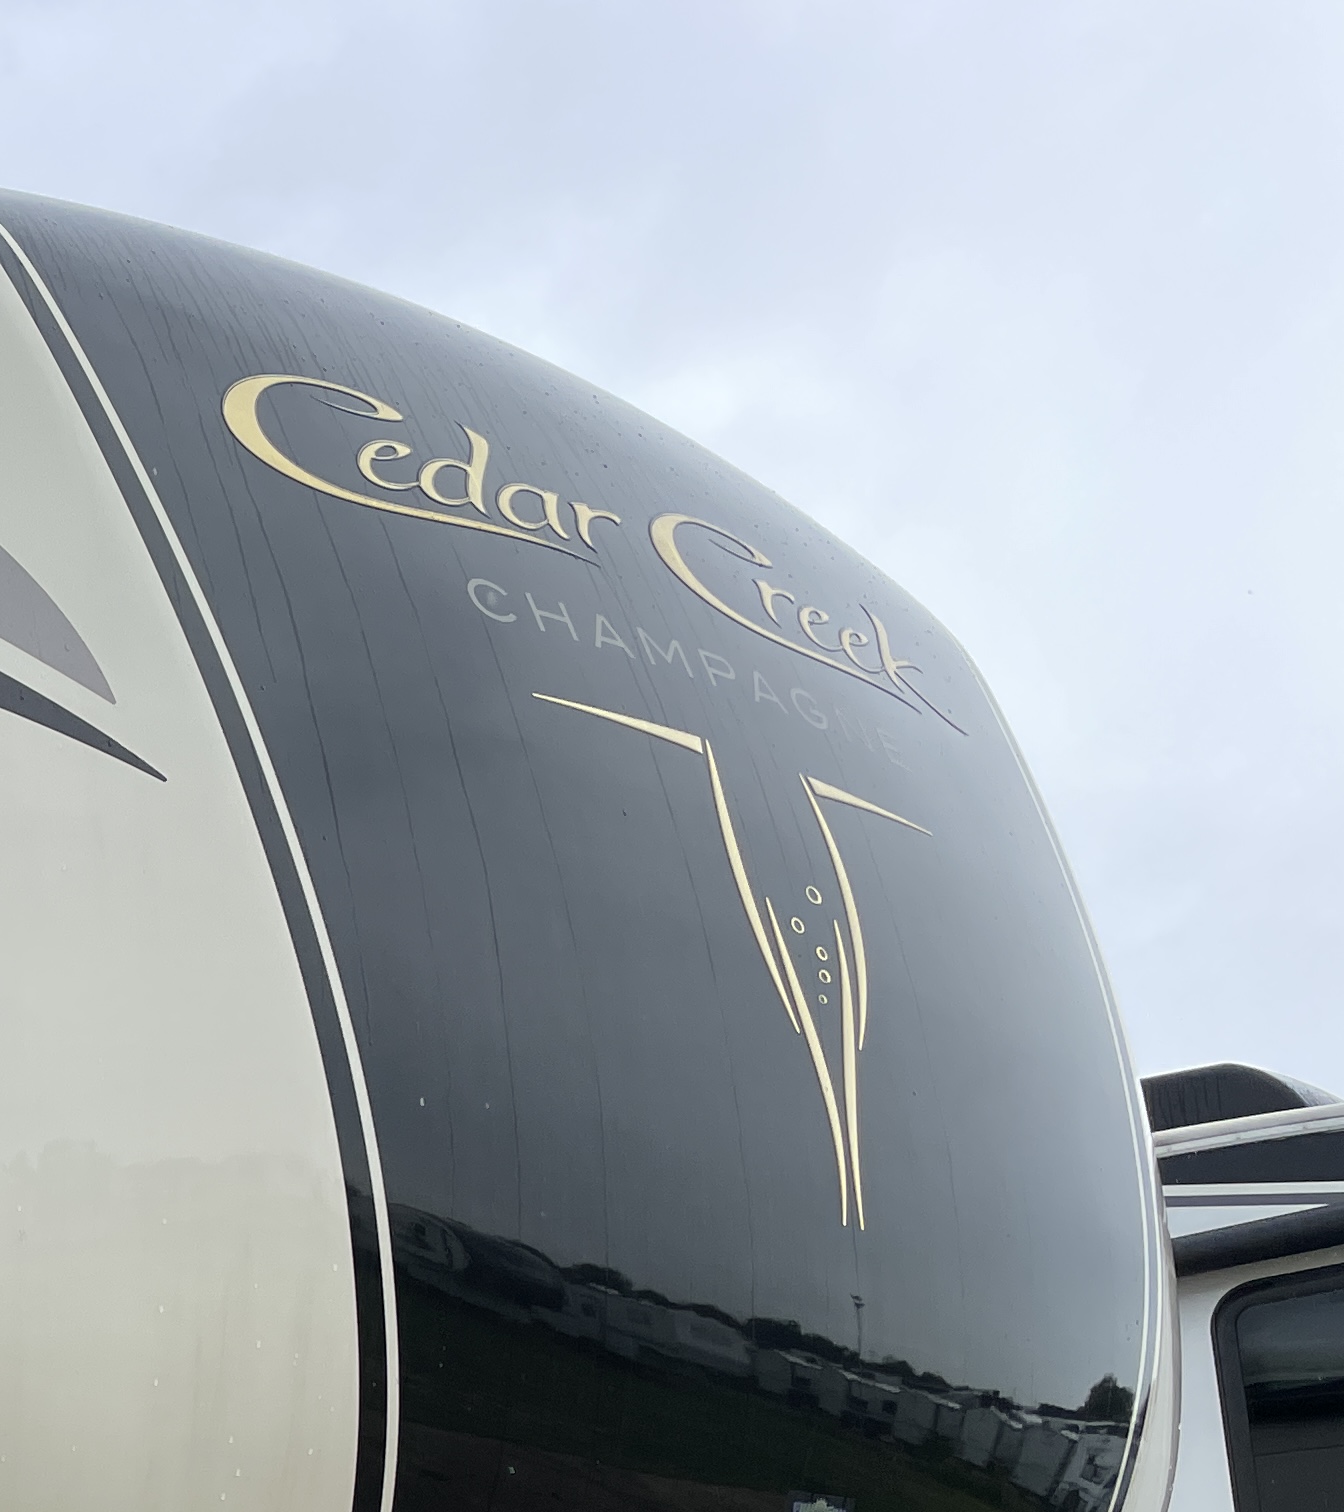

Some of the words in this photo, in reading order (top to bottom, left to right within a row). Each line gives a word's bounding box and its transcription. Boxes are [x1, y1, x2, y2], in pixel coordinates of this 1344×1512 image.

[222, 373, 621, 567] Cedar
[650, 512, 968, 736] Creek
[467, 577, 909, 770] CHAMPAGNE
